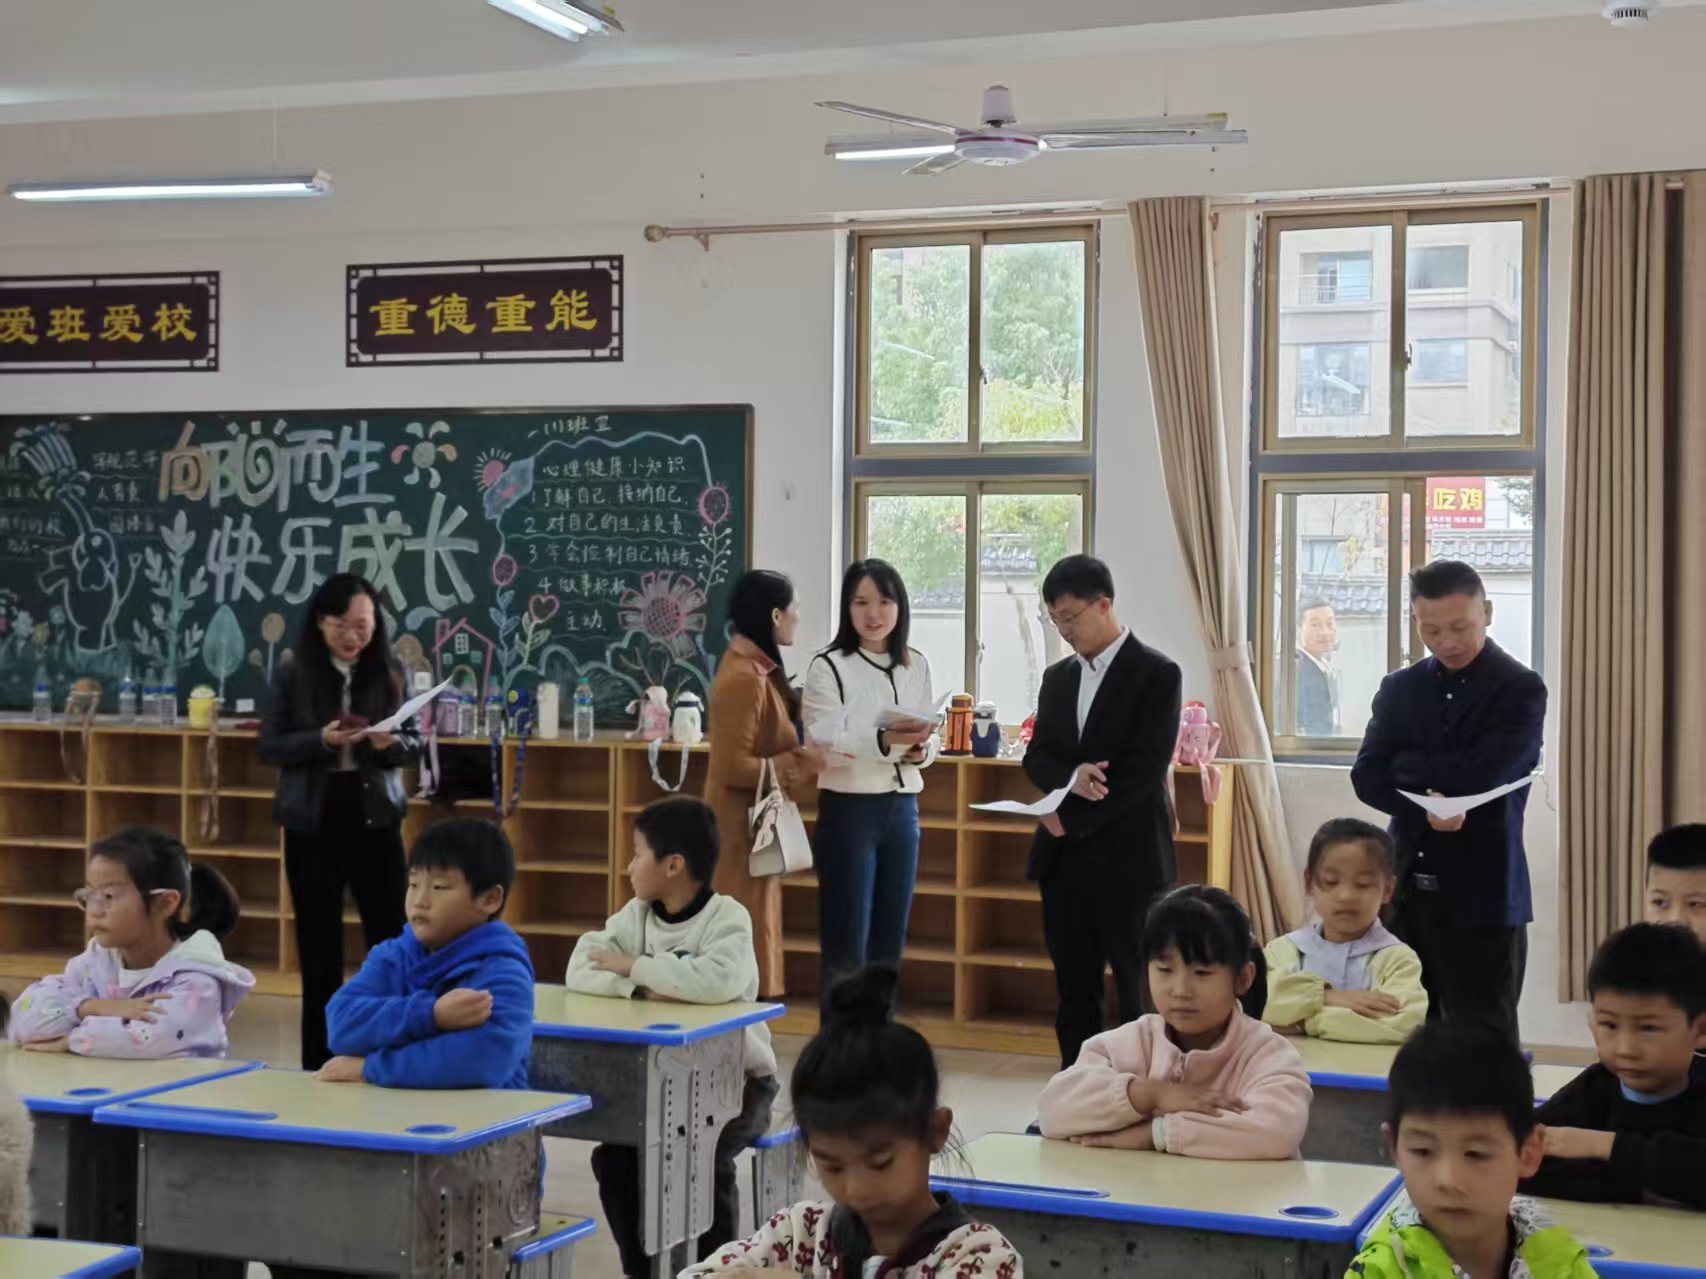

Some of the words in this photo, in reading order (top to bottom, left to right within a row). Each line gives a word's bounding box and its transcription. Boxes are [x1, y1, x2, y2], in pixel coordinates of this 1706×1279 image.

[0, 303, 198, 345] 爱班爱校
[369, 289, 599, 337] 重德重能
[158, 419, 395, 512] 向阳而生
[542, 456, 686, 478] 心理健康小知识
[1426, 487, 1484, 511] 吃鸡
[206, 492, 480, 612] 快乐成长
